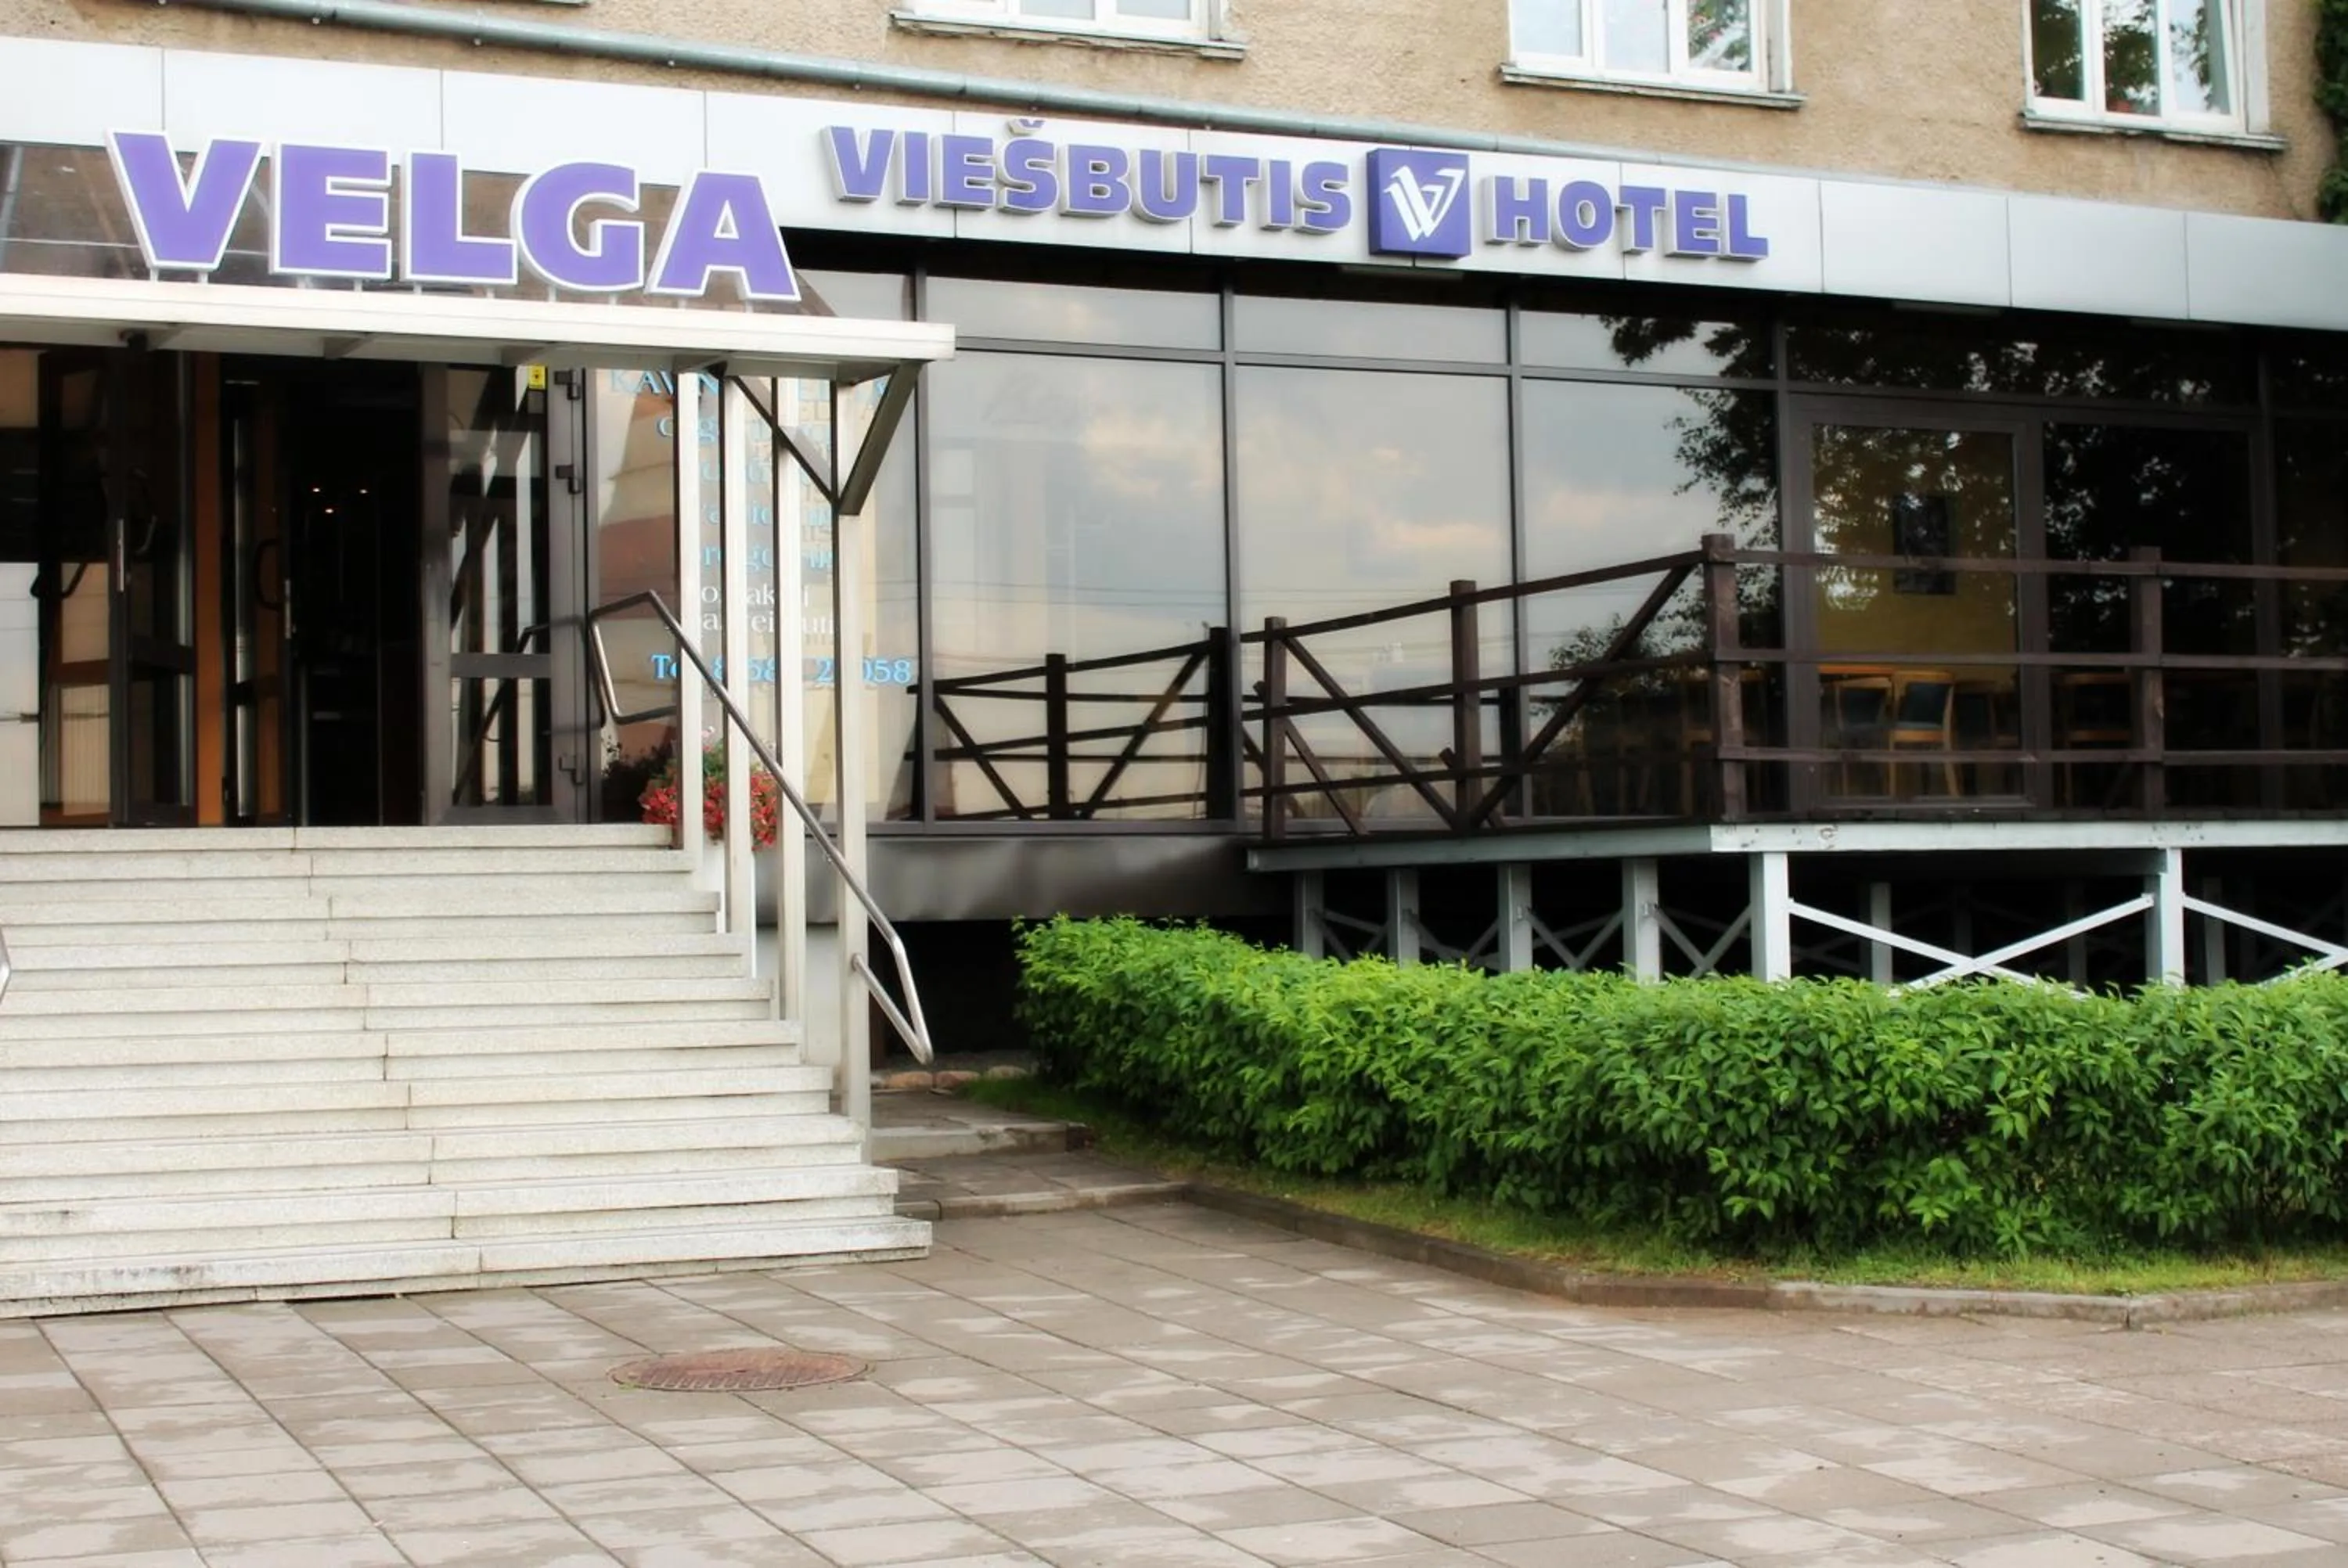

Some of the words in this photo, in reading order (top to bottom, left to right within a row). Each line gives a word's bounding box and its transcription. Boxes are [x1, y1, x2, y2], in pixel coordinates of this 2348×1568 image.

[107, 129, 801, 302] VELGA
[828, 117, 1353, 235] VIEŠBUTIS
[1488, 174, 1770, 261] HOTEL
